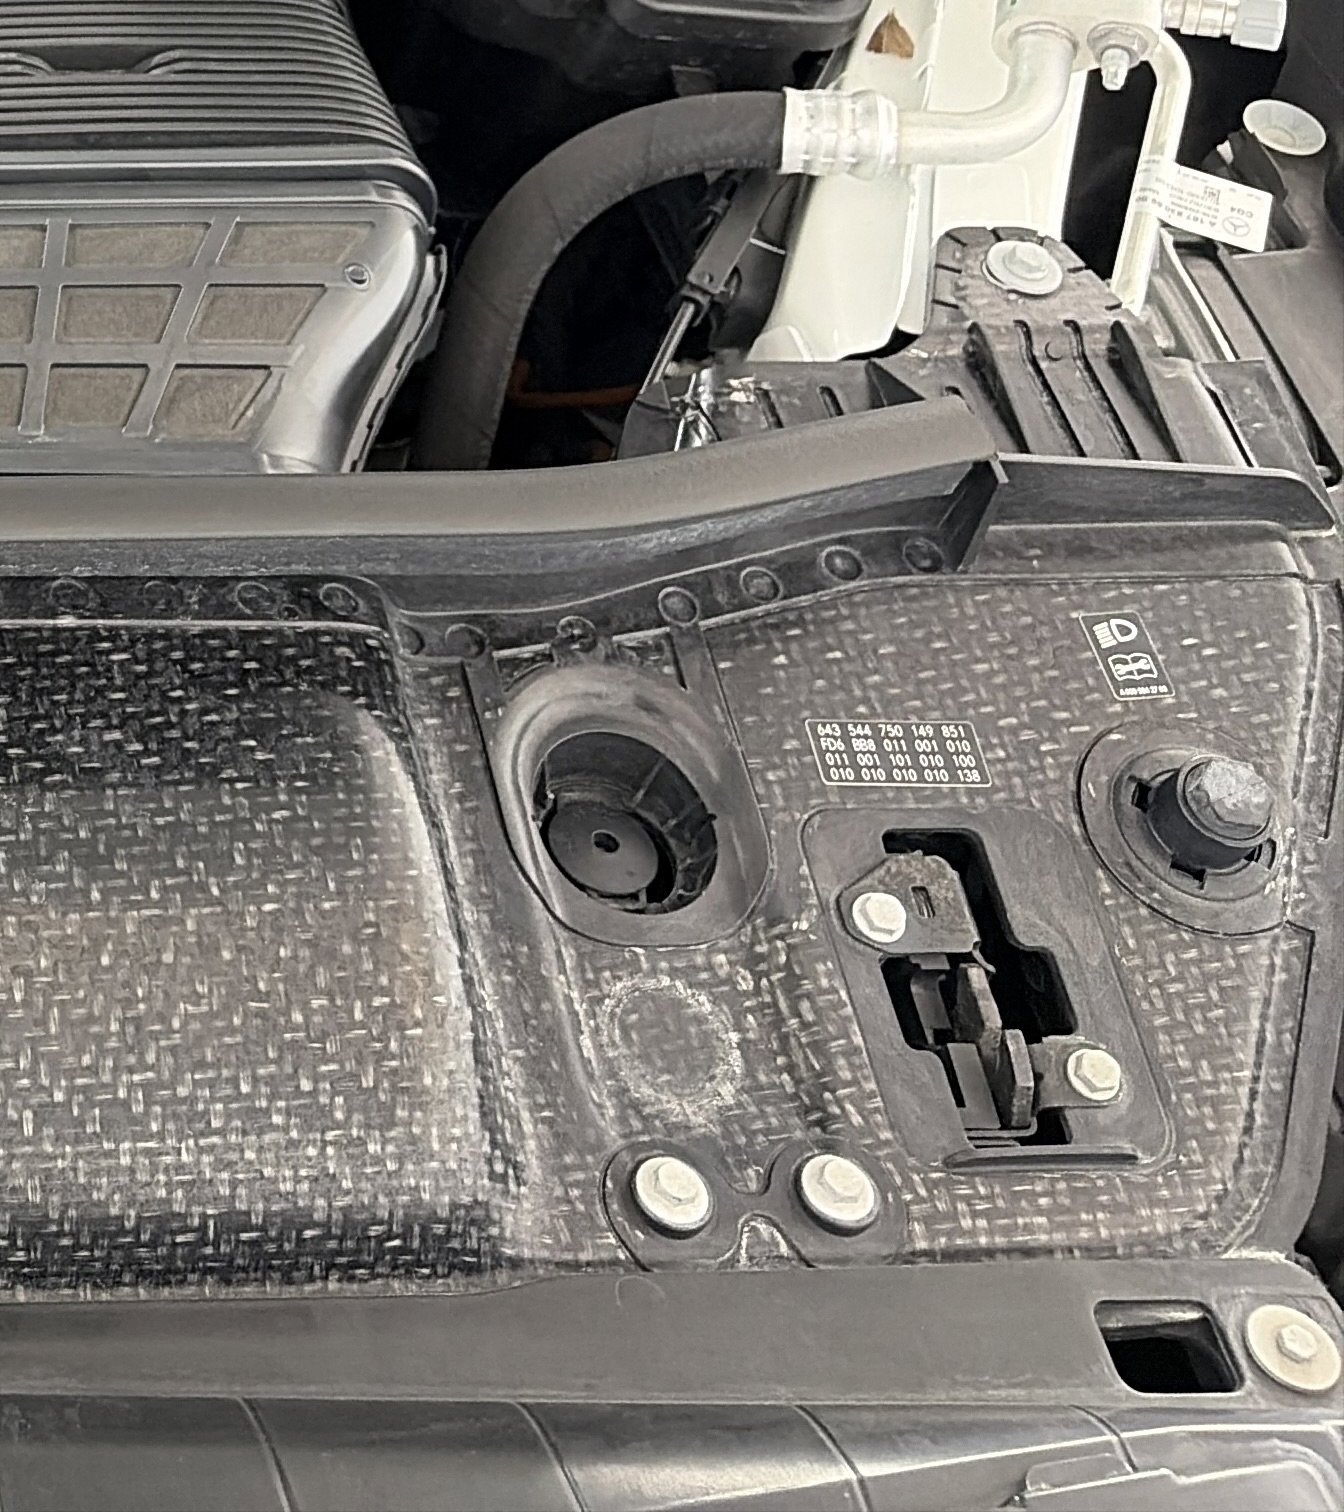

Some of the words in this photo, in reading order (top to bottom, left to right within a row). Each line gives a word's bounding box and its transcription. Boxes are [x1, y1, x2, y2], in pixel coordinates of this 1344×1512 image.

[817, 724, 841, 736] 643
[847, 724, 872, 737] 544
[878, 724, 903, 737] 750
[911, 725, 934, 737] 149
[941, 725, 965, 738] 851
[820, 738, 845, 751] FD6
[852, 738, 876, 751] BB8
[883, 739, 907, 752] 011
[914, 739, 938, 752] 001
[946, 740, 971, 752] 010
[825, 753, 849, 765] 011
[857, 753, 880, 766] 001
[889, 754, 912, 766] 101
[919, 754, 944, 767] 010
[952, 754, 976, 767] 100
[830, 767, 854, 780] 010
[862, 768, 886, 780] 010
[893, 768, 917, 781] 010
[924, 769, 949, 781] 010
[957, 769, 981, 782] 138
